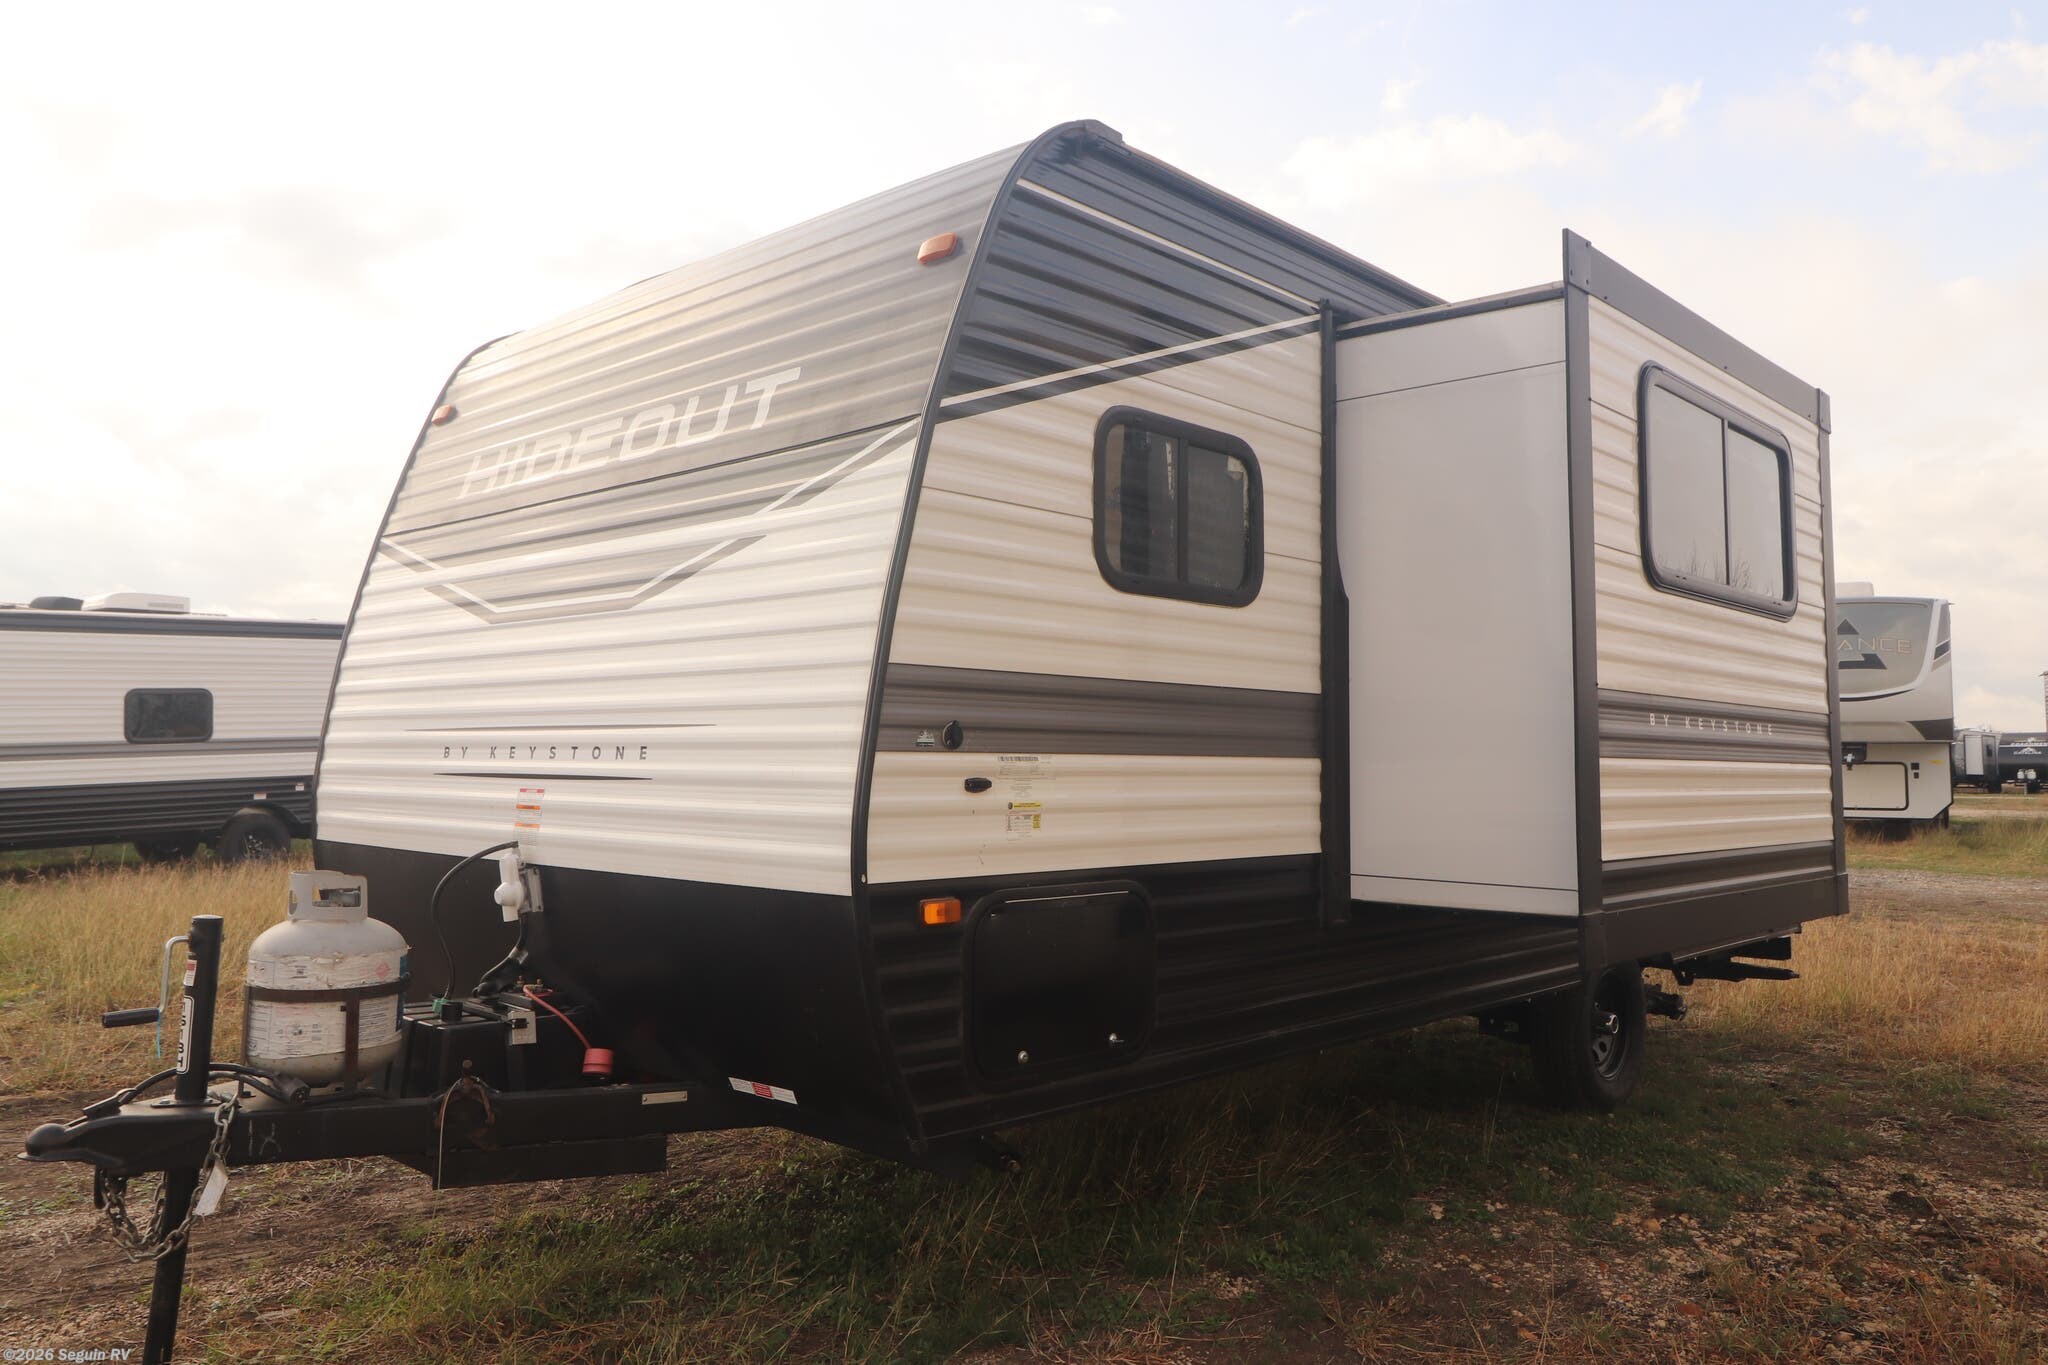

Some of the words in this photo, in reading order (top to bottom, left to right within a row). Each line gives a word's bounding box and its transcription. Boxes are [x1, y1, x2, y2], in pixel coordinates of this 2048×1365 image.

[457, 366, 802, 500] HIDEOUT
[1649, 712, 1670, 729] BY
[1685, 715, 1774, 736] KEYSTONE
[443, 745, 469, 761] BY
[489, 745, 649, 761] KEYSTONE
